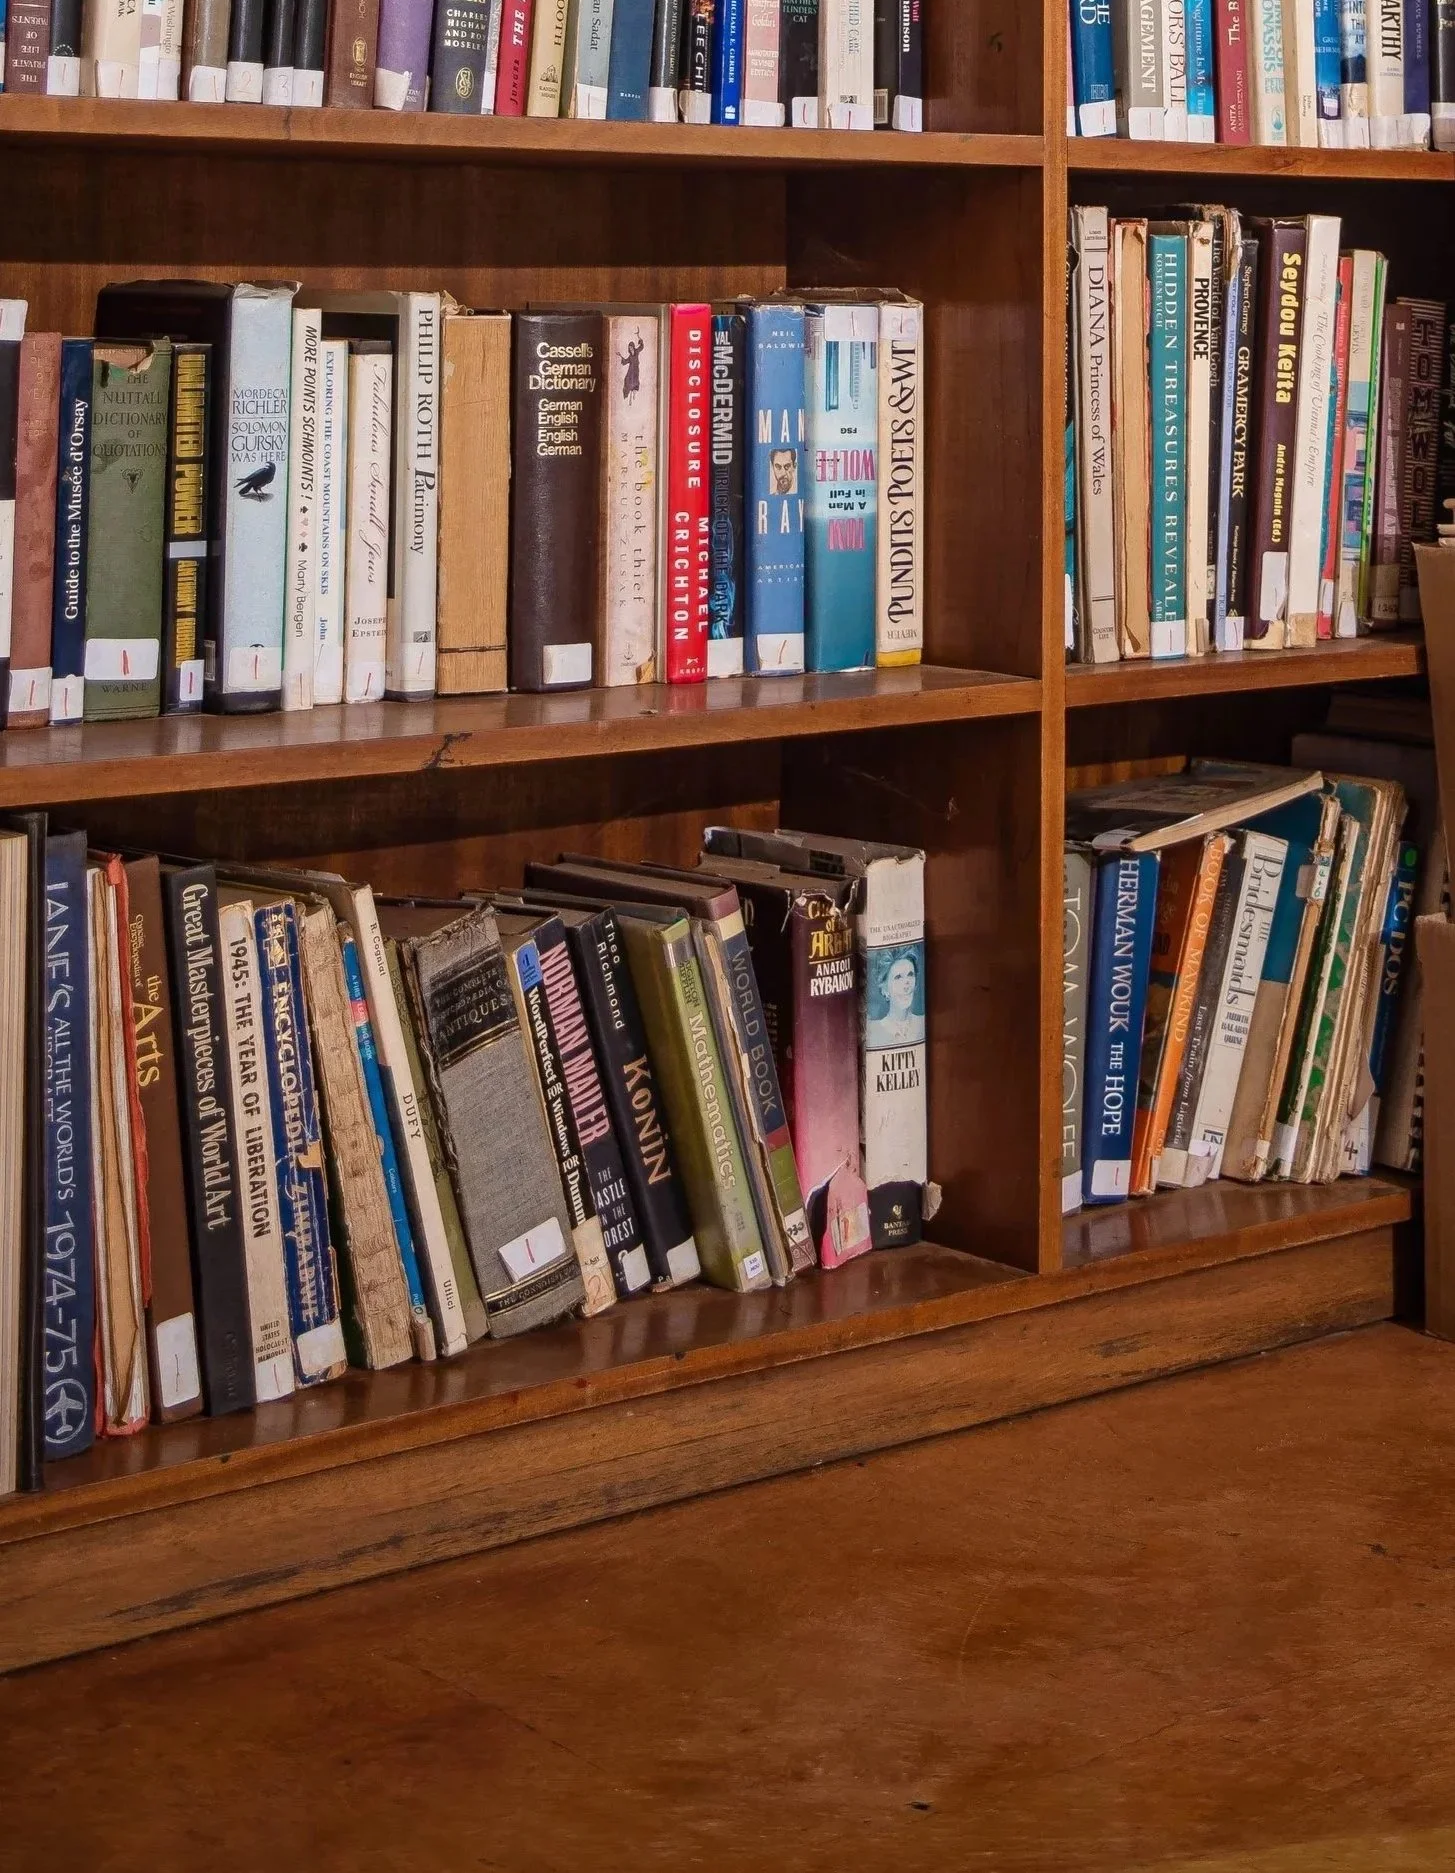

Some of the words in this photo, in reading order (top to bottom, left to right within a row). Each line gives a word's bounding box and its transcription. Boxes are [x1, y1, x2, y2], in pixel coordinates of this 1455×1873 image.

[512, 9, 524, 47] THE
[1227, 16, 1240, 46] The
[1088, 264, 1106, 350] DIANA
[1164, 252, 1178, 349] HIDDEN
[1193, 277, 1209, 361] PROVENCE
[1279, 252, 1302, 337] Seydou
[304, 325, 318, 363] MORE
[417, 308, 434, 385] PHILIP
[536, 342, 593, 359] Cassell's
[539, 361, 592, 377] German
[890, 339, 916, 385] WIT
[303, 367, 317, 413] POINTS
[528, 375, 597, 393] Dictionary
[888, 384, 917, 414] &
[1091, 353, 1104, 421] Princess
[1234, 346, 1250, 447] GRAMERCY
[1275, 344, 1297, 403] Keïta
[69, 398, 88, 462] d'Orsay
[231, 421, 286, 435] SOLOMON
[232, 399, 287, 415] RICHLER
[416, 392, 432, 460] ROTH
[539, 411, 579, 426] English
[688, 330, 702, 489] DISCLOSURE
[1164, 364, 1179, 502] TREASURES
[231, 436, 286, 452] GURSKY
[231, 452, 256, 462] WAS
[260, 451, 286, 462] HERE
[301, 416, 316, 491] SCHMOINTS
[537, 441, 583, 456] German
[1091, 425, 1105, 444] of
[887, 419, 915, 506] POETS,
[1092, 446, 1106, 496] Wales
[1231, 450, 1245, 498] PARK
[64, 466, 85, 520] Musée
[410, 467, 436, 555] Patrimony
[68, 524, 84, 548] the
[68, 550, 81, 565] to
[674, 511, 690, 641] CRICHTON
[887, 509, 915, 623] PUNDITS,
[66, 571, 80, 619] Guide
[1194, 845, 1223, 905] BOOK
[182, 883, 211, 946] Great
[1113, 858, 1140, 957] HERMAN
[1191, 912, 1209, 940] OF
[1225, 853, 1284, 1005] Bridesmaids
[230, 936, 249, 988] 1945:
[604, 920, 621, 963] Theo
[147, 974, 163, 1002] the
[235, 992, 254, 1030] THE
[539, 940, 590, 1055] NORMAN
[596, 942, 625, 1029] Richmond
[1109, 963, 1132, 1032] WOUK
[1174, 947, 1201, 1043] MANKIND
[132, 1002, 165, 1086] Arts
[186, 945, 219, 1093] Masterpieces
[731, 950, 760, 1037] WORLD
[749, 1043, 778, 1117] BOOK
[238, 1035, 257, 1087] YEAR
[876, 1069, 921, 1093] KELLEY
[881, 1049, 917, 1073] KITTY
[1109, 1042, 1124, 1069] THE
[198, 1096, 222, 1117] of
[243, 1092, 261, 1118] OF
[403, 1093, 421, 1140] DUFY
[560, 1051, 611, 1146] MAILER
[688, 1012, 738, 1191] Mathematics
[1102, 1074, 1126, 1136] HOPE
[202, 1118, 228, 1183] World
[206, 1181, 233, 1230] Art
[244, 1126, 272, 1240] LIBERATION
[45, 1210, 78, 1374] 1974-75
